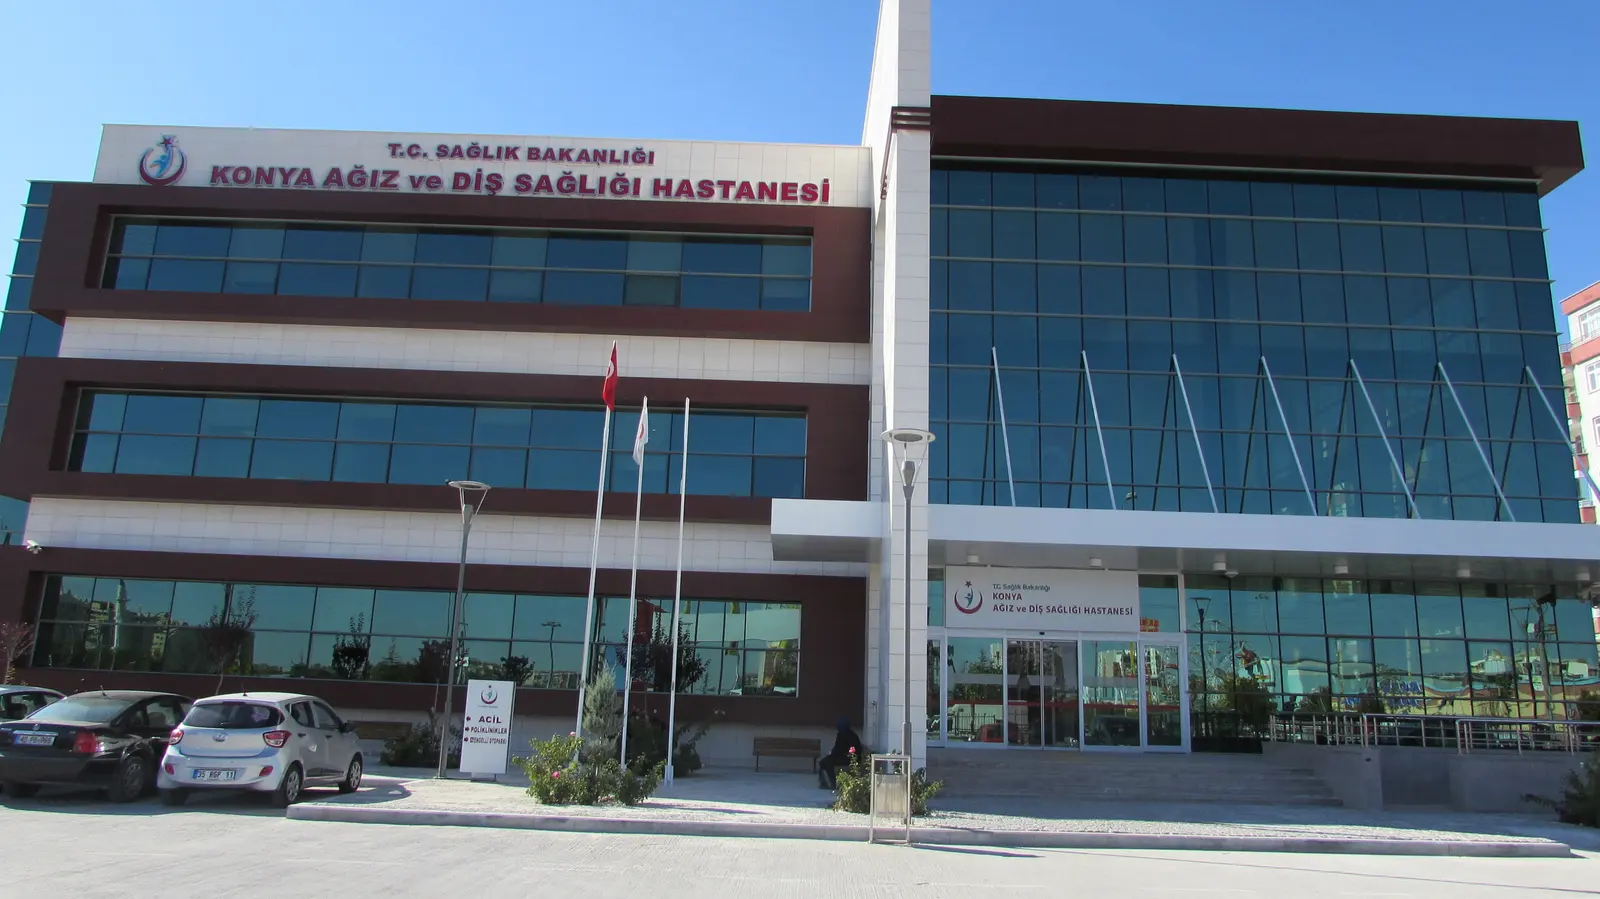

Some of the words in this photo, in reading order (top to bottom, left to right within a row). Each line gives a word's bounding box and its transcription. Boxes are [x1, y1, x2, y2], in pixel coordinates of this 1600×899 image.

[388, 143, 428, 158] T.C.
[436, 142, 520, 161] SAĞLIK
[527, 146, 655, 165] BAKANLIĞI
[210, 165, 315, 187] KONYA
[323, 164, 400, 190] AĞIZ
[410, 173, 442, 189] ve
[452, 168, 504, 195] DİŞ
[514, 171, 641, 197] SAĞLIĞI
[653, 178, 831, 204] HASTANESİ
[993, 603, 1014, 612] AĞIZ
[1029, 603, 1043, 616] DİŞ
[1046, 604, 1081, 615] SAĞLIĞI
[1084, 606, 1133, 616] HASTANESİ
[479, 715, 501, 724] ACİL
